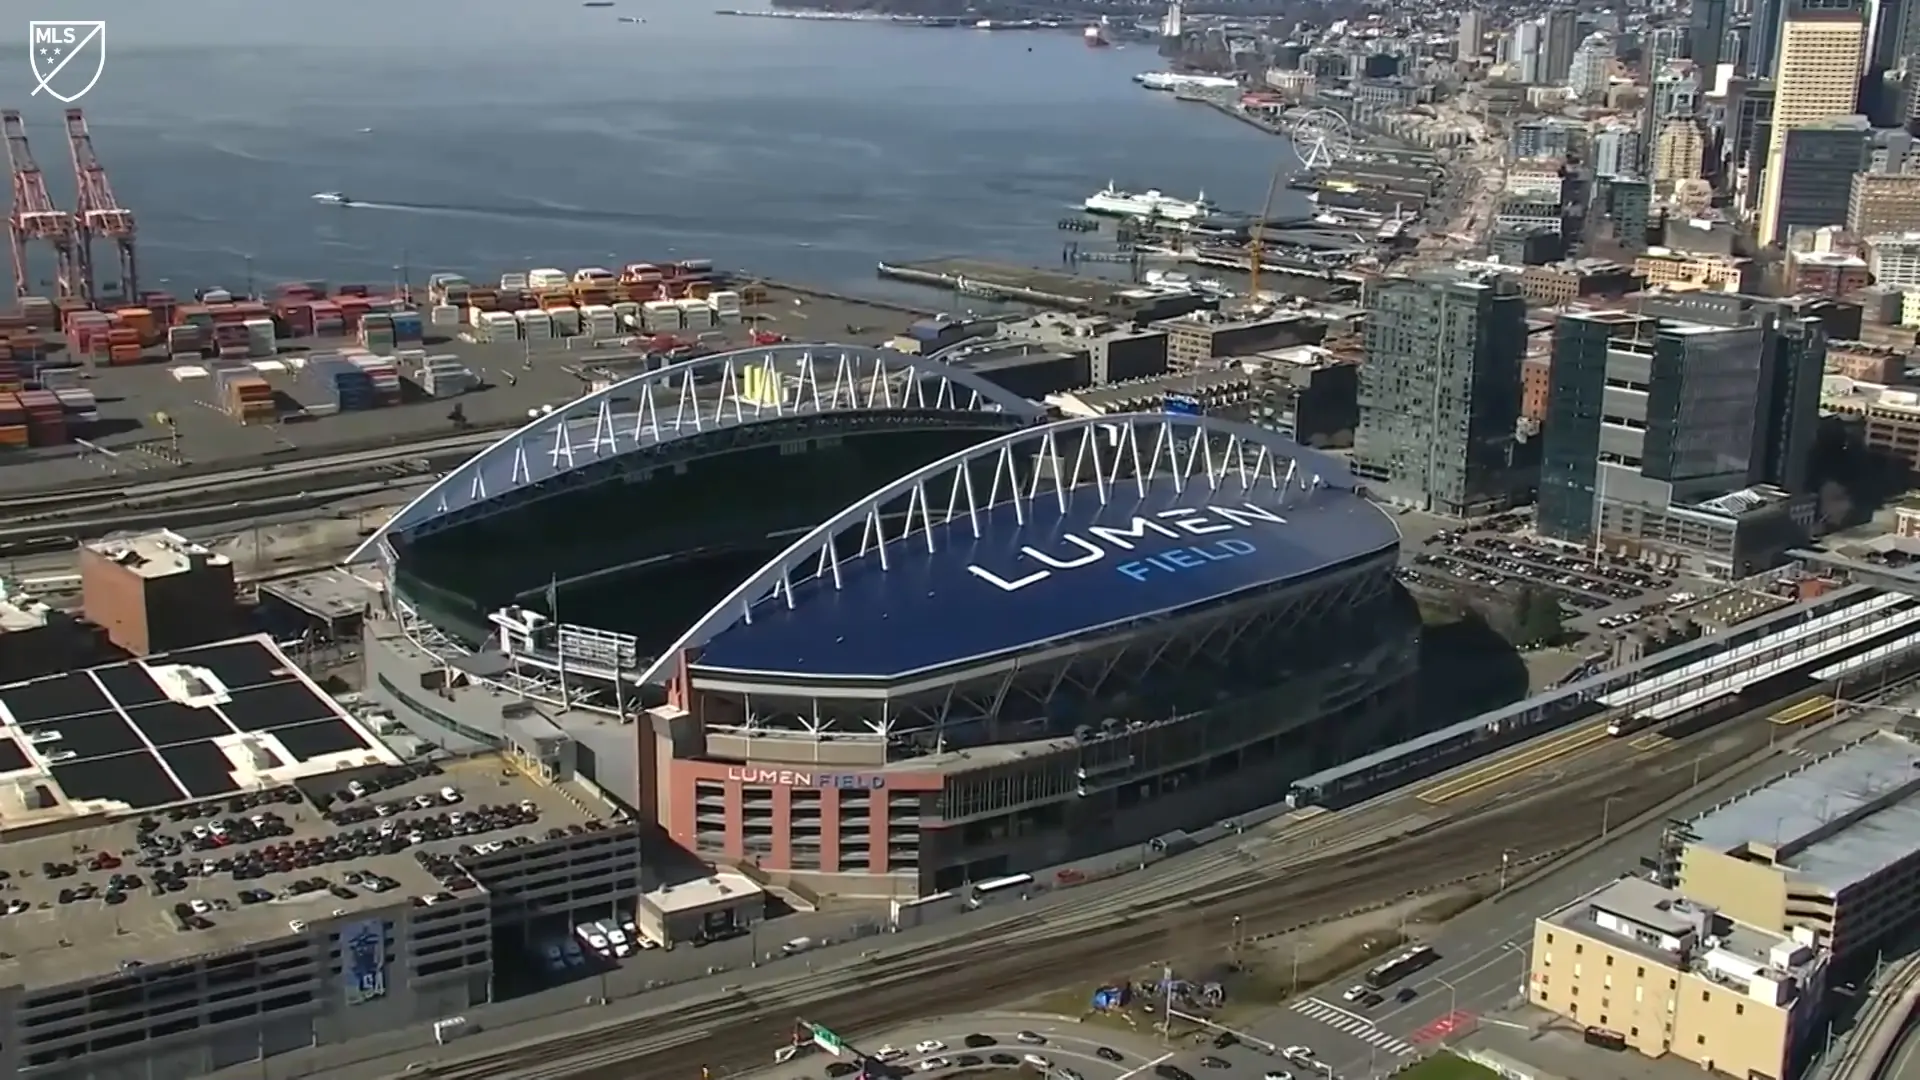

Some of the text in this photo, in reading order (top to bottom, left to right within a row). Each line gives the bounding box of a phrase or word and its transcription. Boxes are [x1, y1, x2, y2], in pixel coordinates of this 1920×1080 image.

[967, 502, 1288, 591] LUMEN
[1117, 538, 1257, 582] FIELD
[728, 767, 885, 790] LUMEN FIELD
